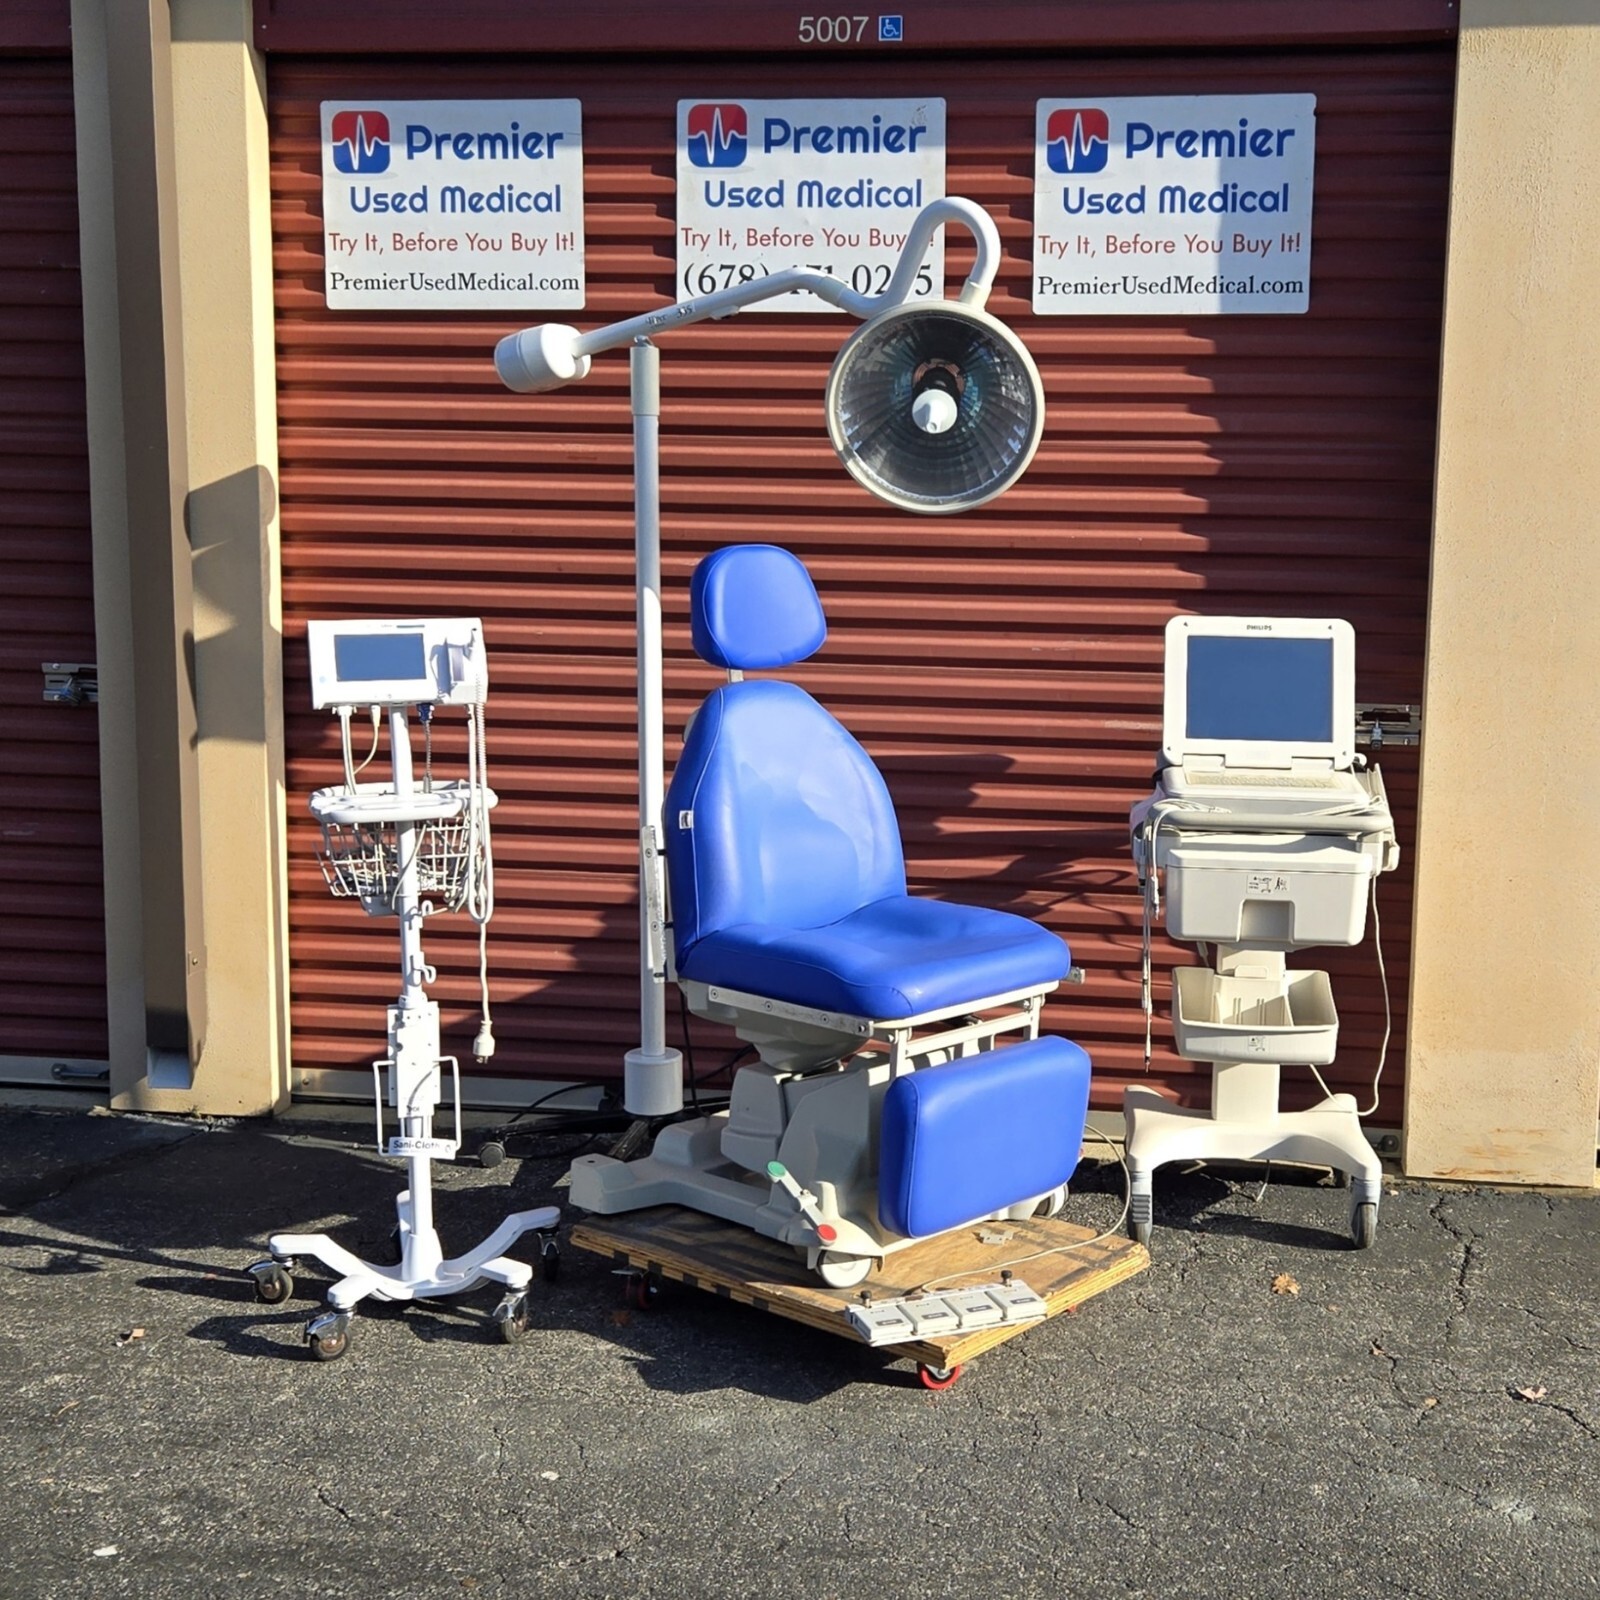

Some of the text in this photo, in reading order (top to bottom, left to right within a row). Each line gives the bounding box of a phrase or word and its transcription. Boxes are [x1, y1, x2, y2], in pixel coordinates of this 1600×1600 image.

[799, 16, 869, 42] 5007
[406, 121, 564, 160] Premier
[764, 115, 927, 154] Premier
[1125, 118, 1295, 159] Premier
[350, 184, 561, 213] Used Medical
[704, 178, 922, 208] Used Medical
[1063, 182, 1289, 214] Used Medical
[328, 231, 575, 256] Try It, Before You Buy It!
[681, 228, 710, 251] Try
[718, 227, 737, 250] It,
[746, 227, 814, 247] Before
[821, 228, 860, 247] You
[869, 228, 907, 252] Buy
[1038, 232, 1301, 259] Try It, Before You Buy It!
[330, 272, 580, 291] PremierUsedMedical.com
[1038, 276, 1304, 295] PremierUsedMedical.com
